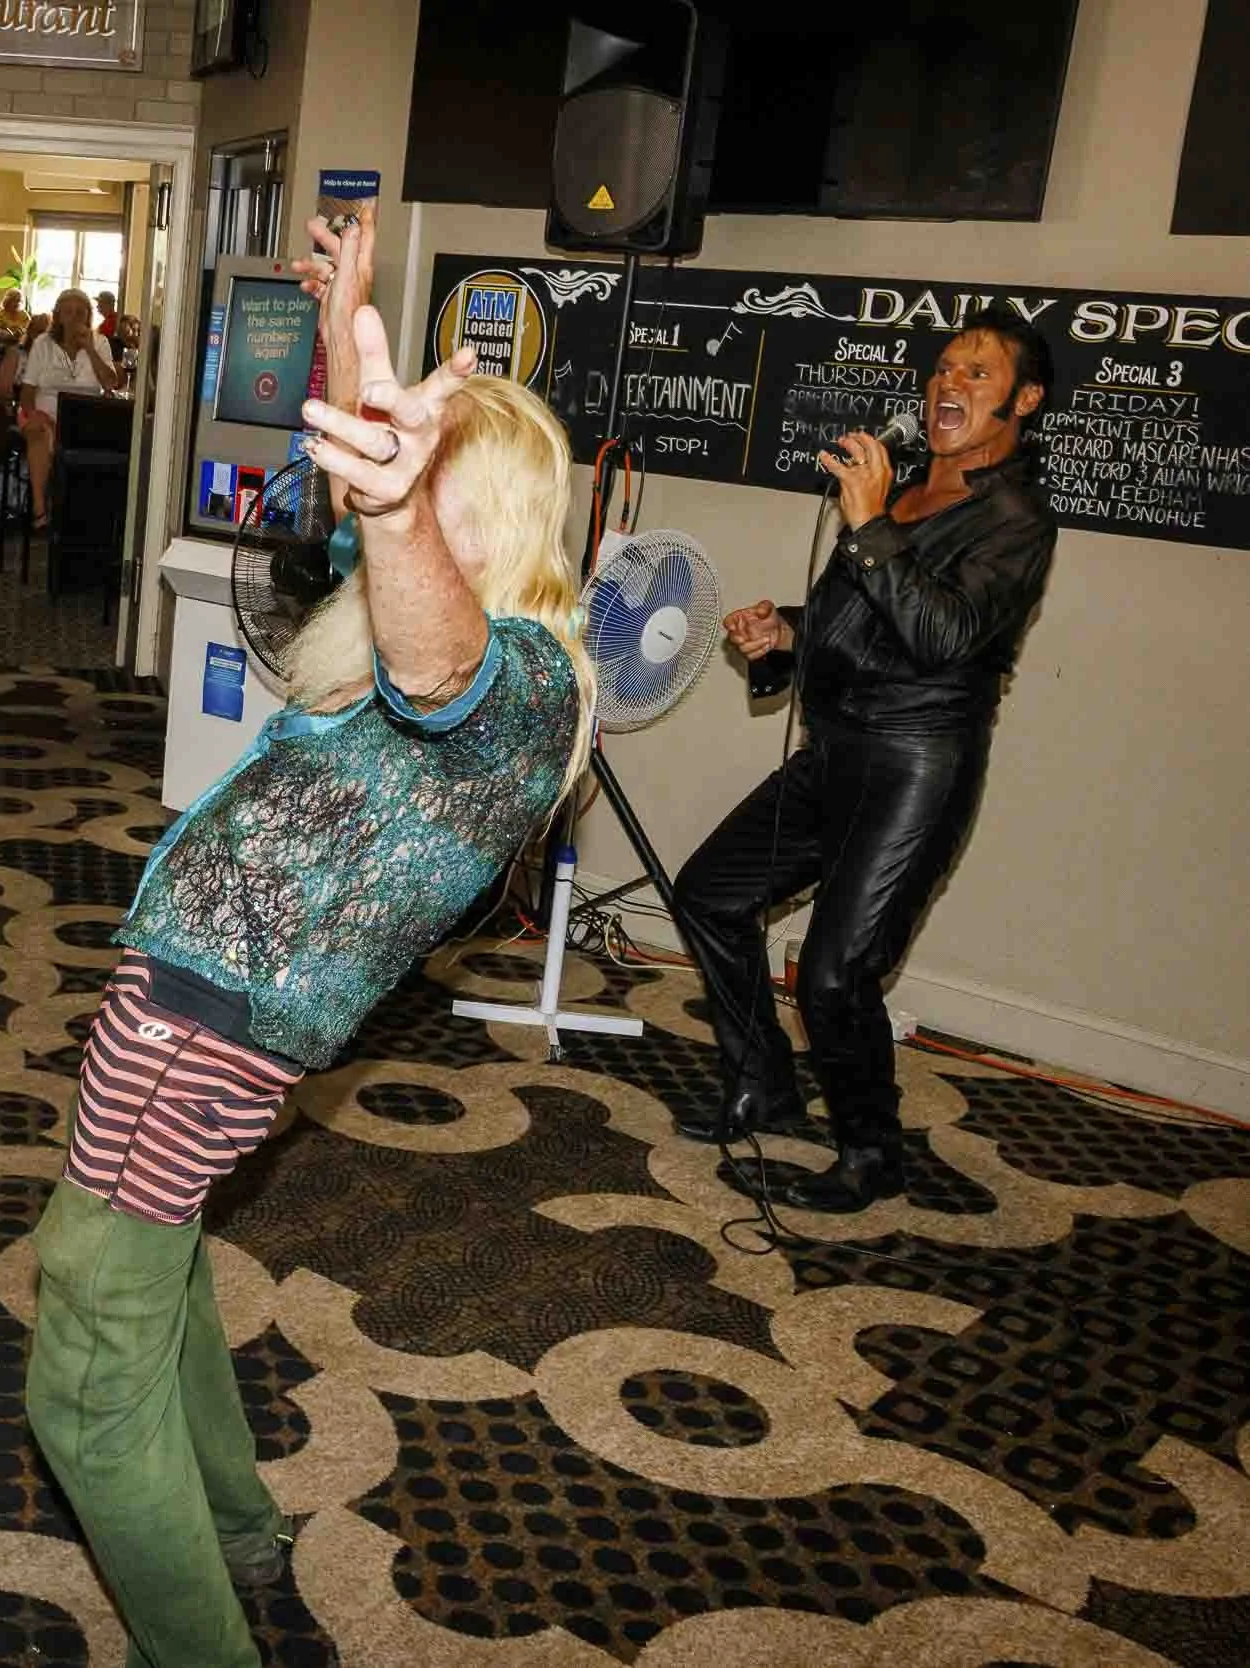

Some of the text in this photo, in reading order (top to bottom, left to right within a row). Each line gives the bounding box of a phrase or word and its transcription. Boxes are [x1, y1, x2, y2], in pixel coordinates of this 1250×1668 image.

[242, 298, 313, 314] Want to play
[466, 289, 516, 321] ATM
[247, 314, 302, 328] the same
[464, 318, 514, 338] Located
[246, 330, 300, 344] numbers
[628, 321, 680, 346] SPECAL 1
[835, 337, 907, 364] SPECIAL 2
[474, 360, 503, 377] stro
[794, 363, 918, 391] THURSDAY!
[1095, 356, 1183, 387] SPECIAL 3
[584, 371, 753, 419] ENERTAINMENT
[1071, 389, 1199, 418] FRIDAY!
[654, 435, 709, 455] STOP!
[1142, 422, 1199, 446] ELVIS
[1092, 461, 1132, 482] FORD
[1049, 475, 1099, 498] SEAN
[1049, 494, 1207, 528] ROYDEN DONOHUE
